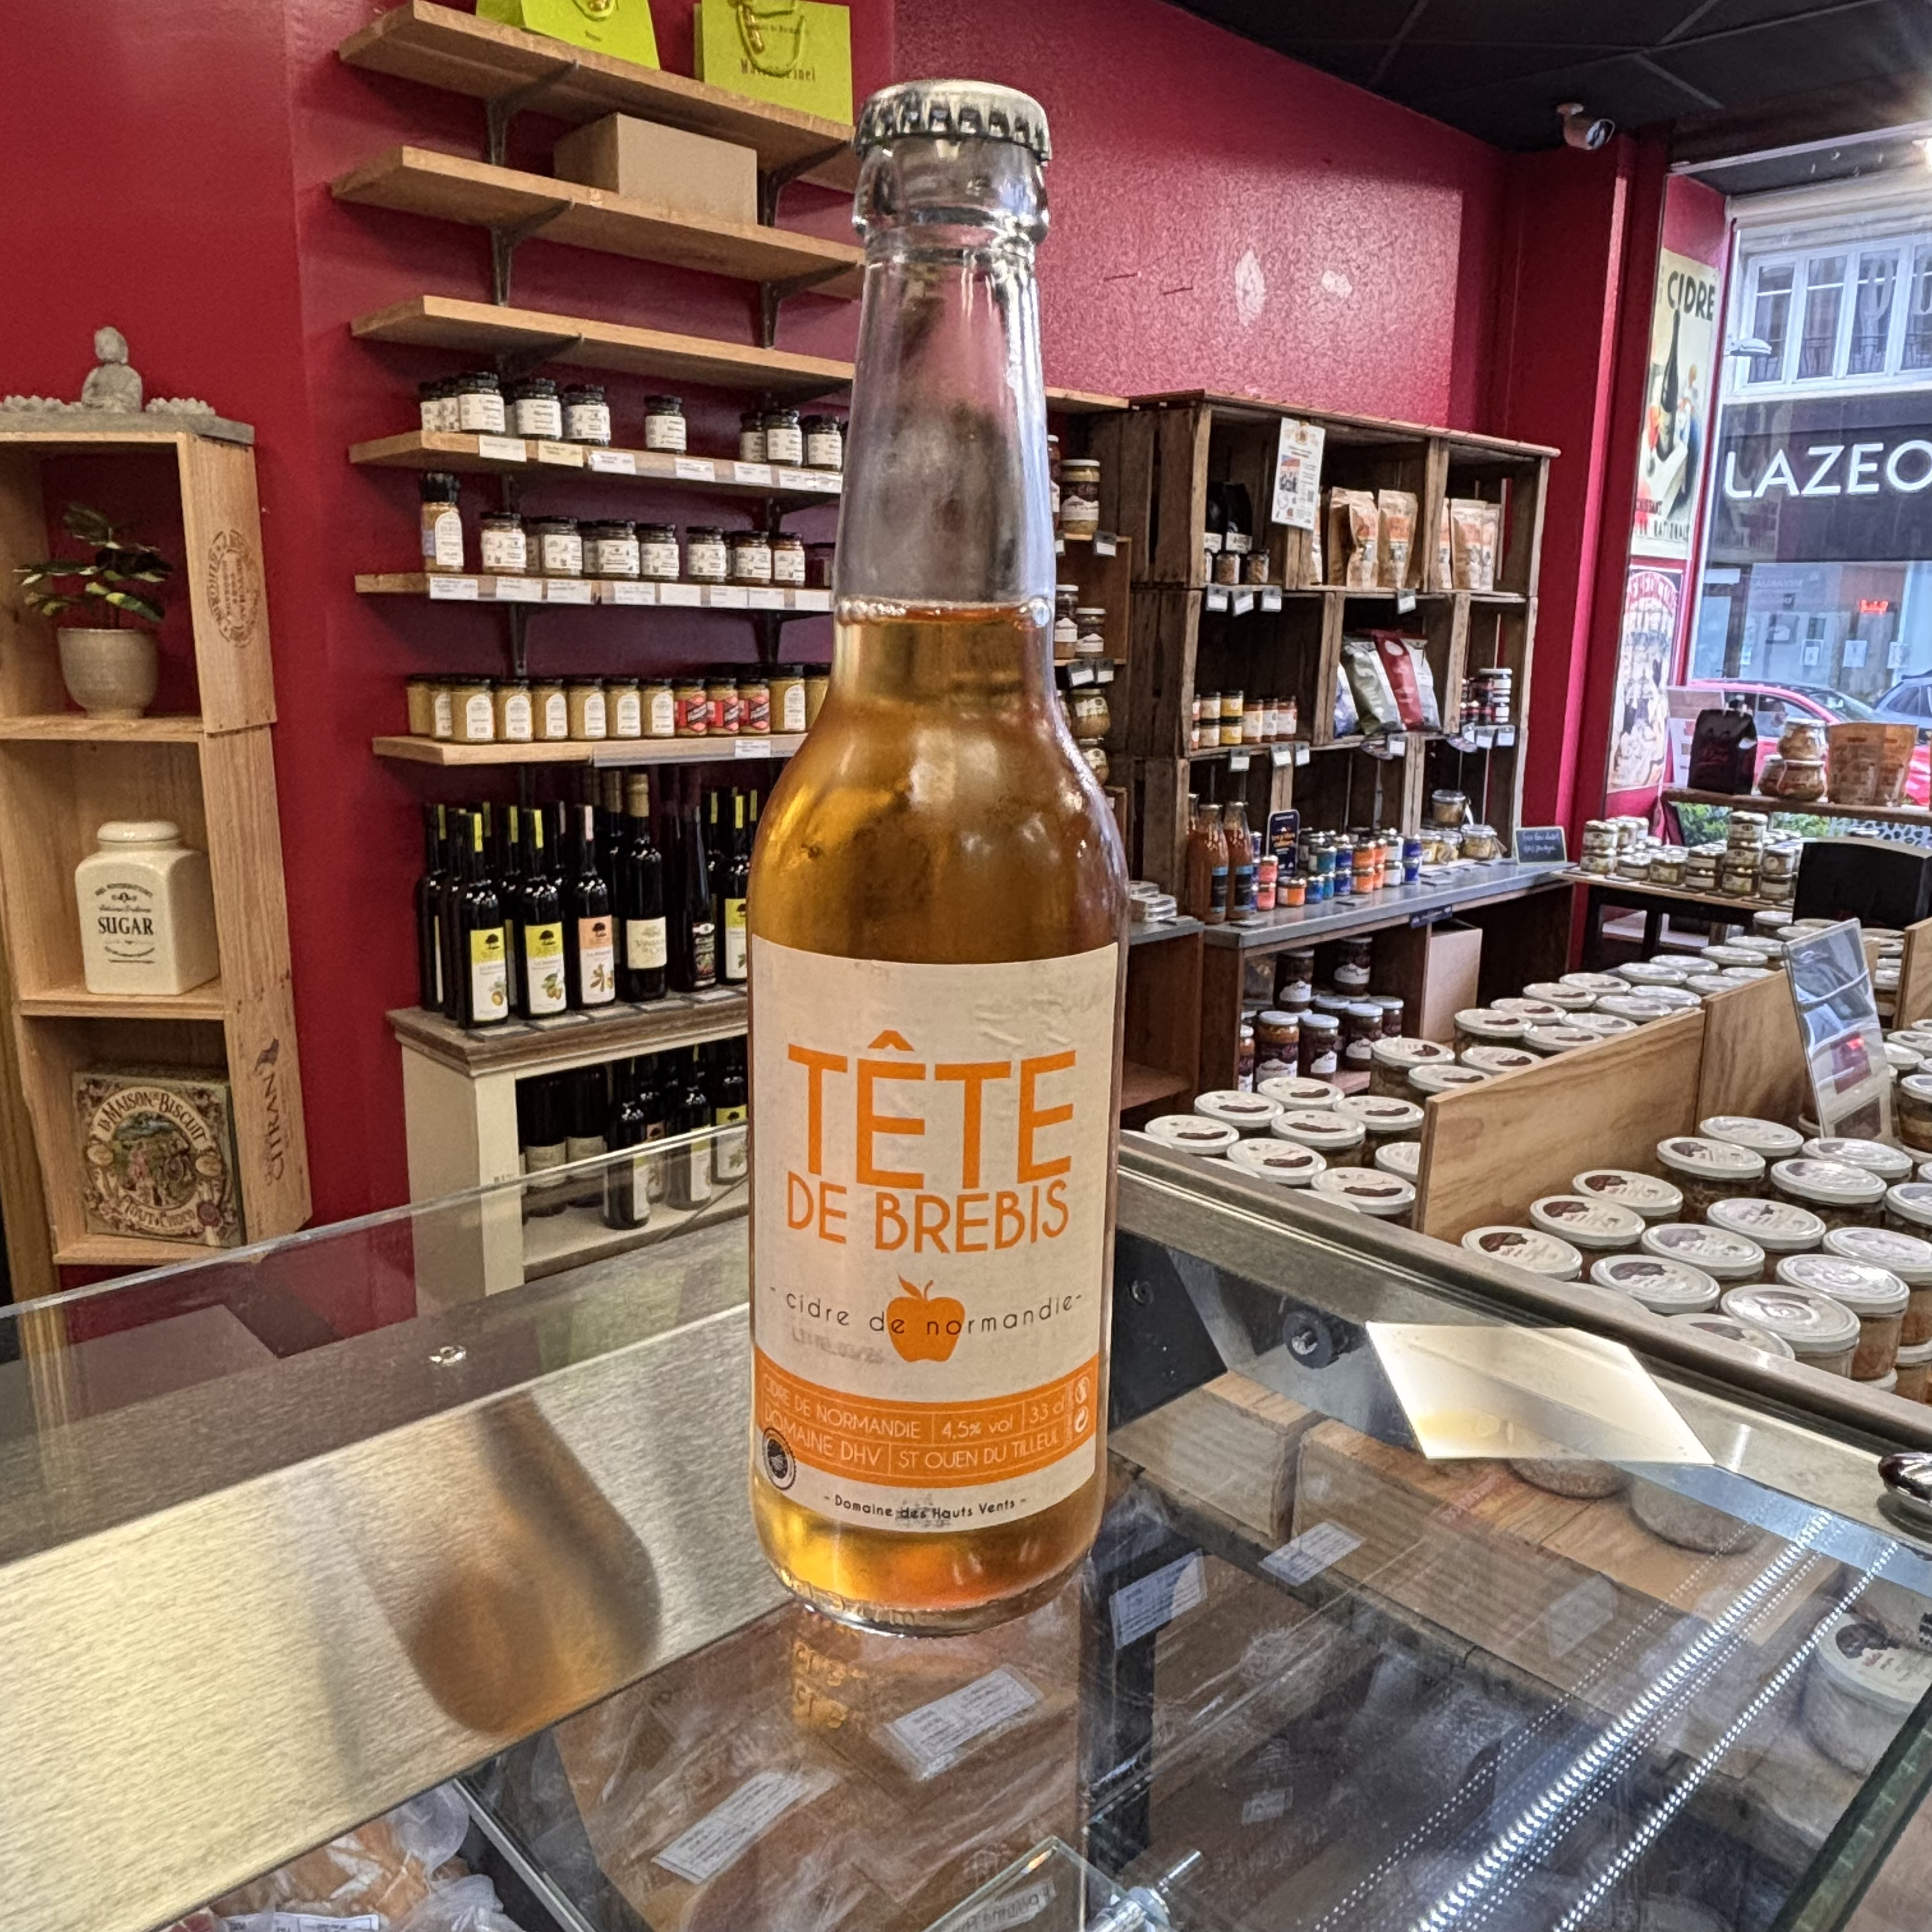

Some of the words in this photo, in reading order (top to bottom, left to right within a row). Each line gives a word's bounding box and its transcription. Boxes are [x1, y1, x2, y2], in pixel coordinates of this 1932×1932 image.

[1667, 270, 1715, 321] CIDRE
[1724, 440, 1932, 499] LAZEO
[98, 916, 154, 936] SUGAR
[102, 1091, 154, 1124] MAISON
[159, 1092, 208, 1141] BISCUIT
[787, 1029, 1076, 1189] TÊTE
[787, 1170, 847, 1244] DE
[875, 1179, 1069, 1254] BREBIS
[786, 1293, 850, 1326] cidre
[869, 1310, 905, 1335] de
[765, 1403, 834, 1457] DOMAINE
[840, 1440, 882, 1466] DHV
[794, 1394, 811, 1417] DE
[816, 1400, 921, 1439] NORMANDIE
[988, 1413, 1014, 1434] vol
[898, 1450, 921, 1468] ST
[924, 1450, 978, 1469] OUEN
[983, 1445, 1008, 1465] DU
[1011, 1429, 1059, 1459] TILLEUL
[834, 1494, 893, 1517] Domaine
[900, 1506, 926, 1519] des
[933, 1506, 973, 1520] Hauts
[978, 1499, 1015, 1515] Vents
